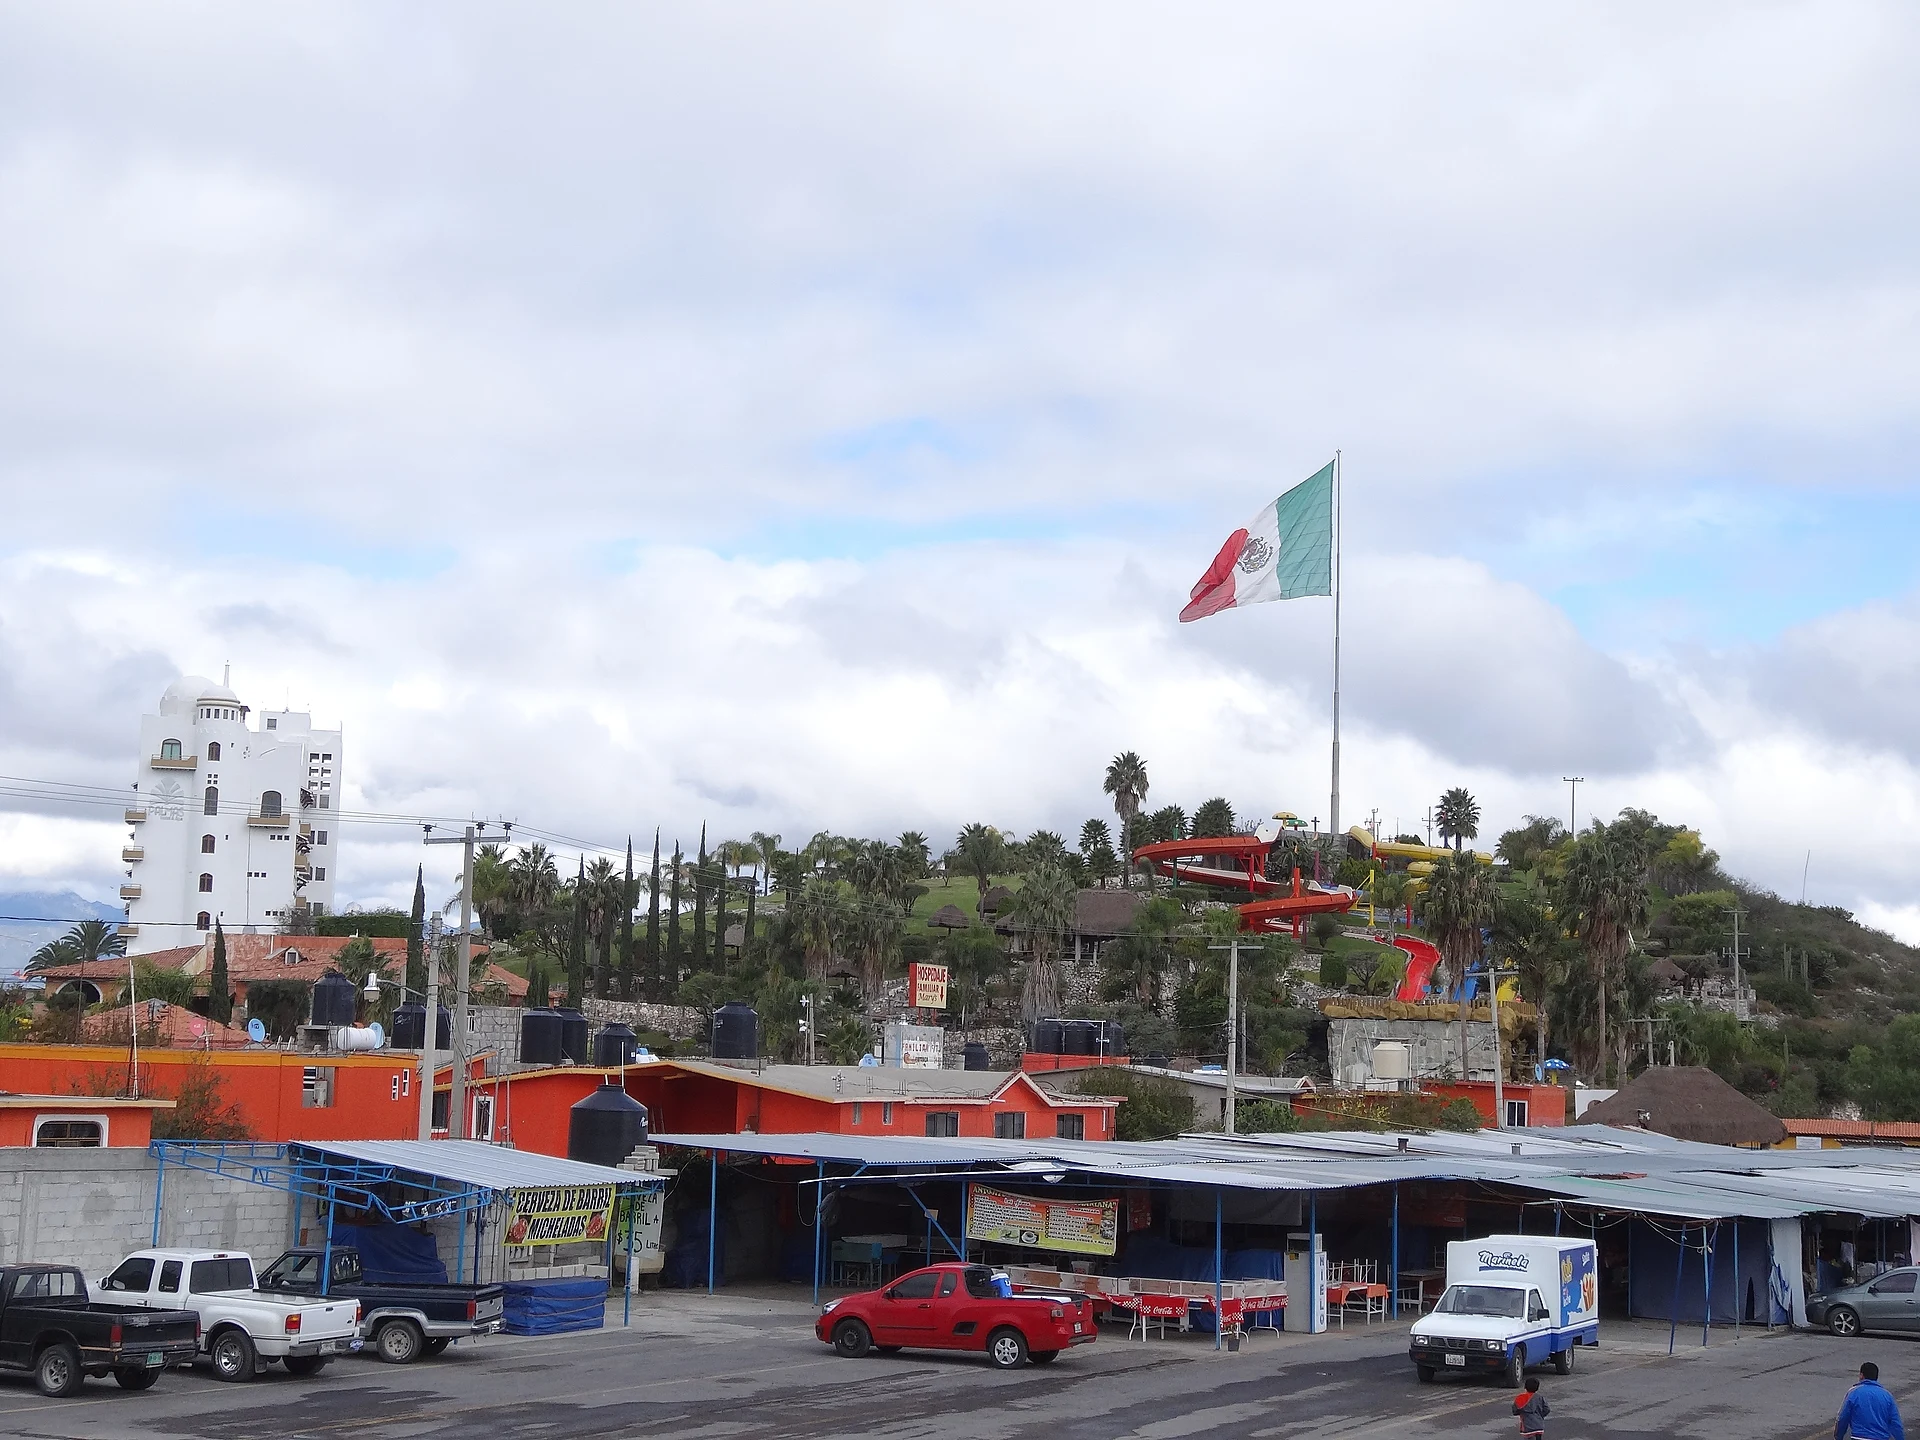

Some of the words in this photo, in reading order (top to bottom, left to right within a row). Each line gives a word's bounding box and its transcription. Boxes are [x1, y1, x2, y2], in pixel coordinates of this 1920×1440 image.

[917, 966, 946, 983] HOSPEDAJE
[917, 984, 940, 993] FAMILIAR
[516, 1190, 562, 1214] CERVEZA
[562, 1189, 576, 1212] DE
[576, 1188, 612, 1212] BARRIL
[635, 1202, 645, 1212] DE
[527, 1214, 588, 1240] MICHELADAS
[1478, 1250, 1530, 1268] Marinela
